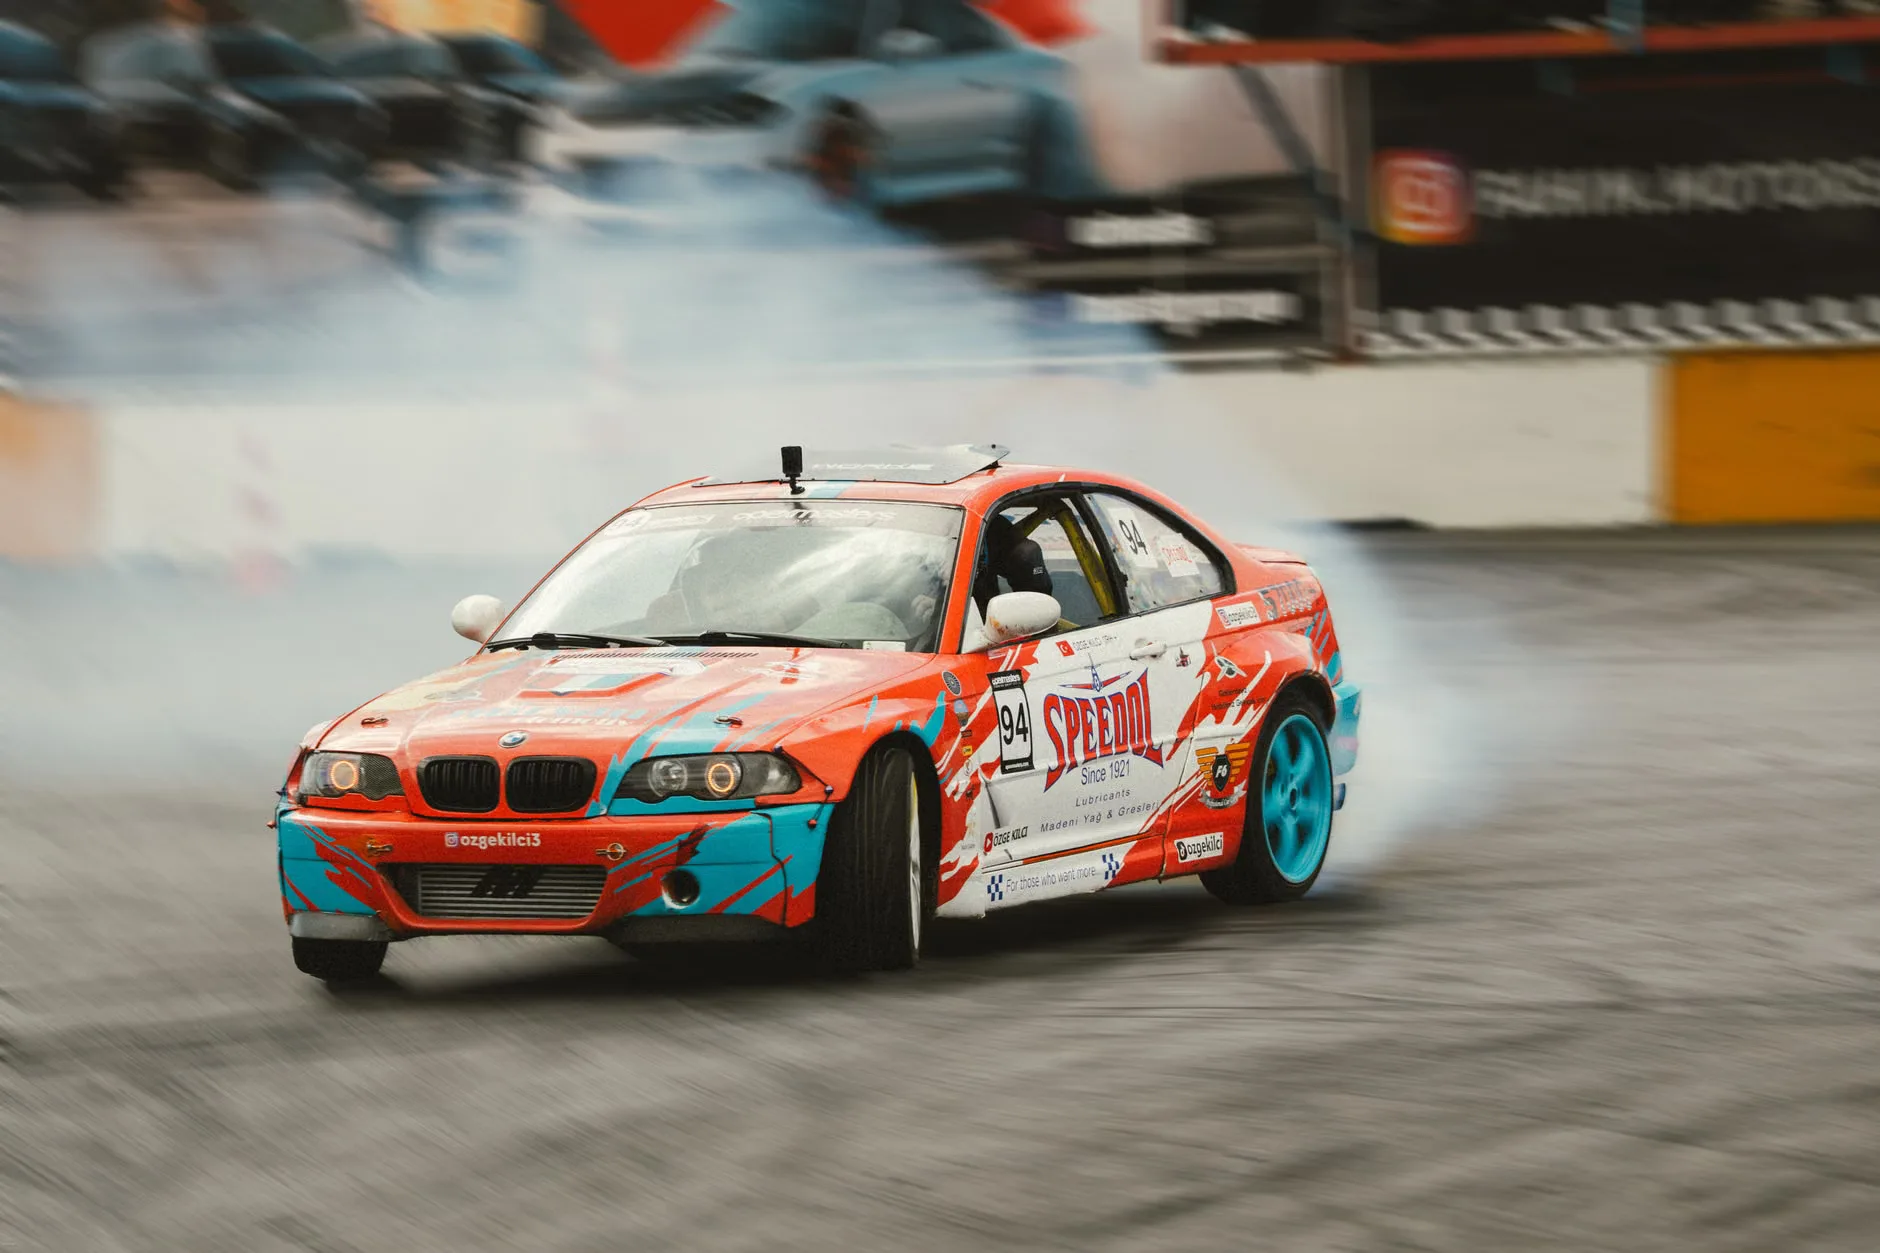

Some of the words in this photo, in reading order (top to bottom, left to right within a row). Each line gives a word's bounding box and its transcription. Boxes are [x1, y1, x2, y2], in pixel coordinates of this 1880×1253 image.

[1118, 519, 1149, 555] 94
[1000, 702, 1029, 745] 94
[1043, 667, 1164, 793] SPEEDOL
[1081, 766, 1106, 785] Since
[1109, 759, 1131, 780] 1921
[1075, 789, 1131, 807] Lubricants
[1040, 817, 1079, 832] Madeni
[1084, 812, 1102, 823] Yağ
[1106, 810, 1113, 819] &
[1118, 801, 1160, 817] Gresleri
[460, 832, 541, 850] ozgekilci3
[993, 832, 1011, 847] ÖZGE
[1187, 834, 1223, 858] ozgekilci
[1006, 879, 1019, 893] For
[1020, 876, 1040, 890] those
[1041, 872, 1057, 886] who
[1058, 869, 1076, 883] want
[1077, 867, 1097, 879] more
